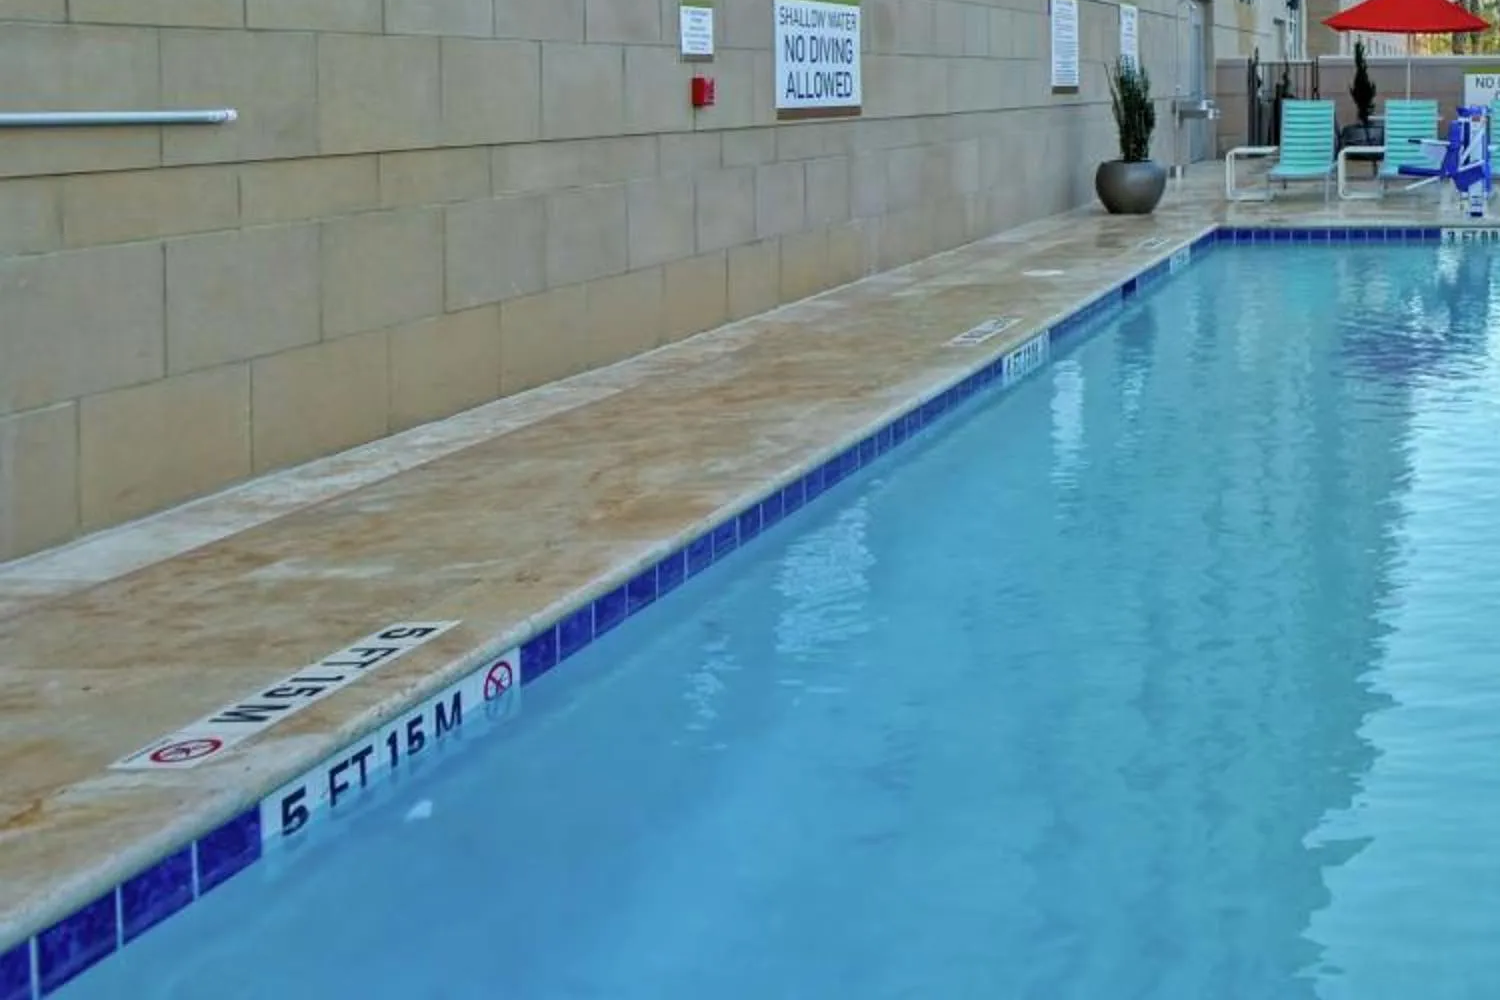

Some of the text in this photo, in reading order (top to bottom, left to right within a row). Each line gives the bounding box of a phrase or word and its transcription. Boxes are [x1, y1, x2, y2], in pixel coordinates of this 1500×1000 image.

[780, 6, 857, 31] SHALLOW WATER
[785, 35, 854, 64] NO DIVING
[785, 71, 853, 99] ALLOWED
[1475, 75, 1494, 89] NO
[379, 627, 437, 639] 5
[322, 647, 399, 669] FT
[208, 704, 292, 723] M
[281, 786, 310, 836] 5
[328, 745, 373, 808] FT
[434, 690, 463, 738] M
